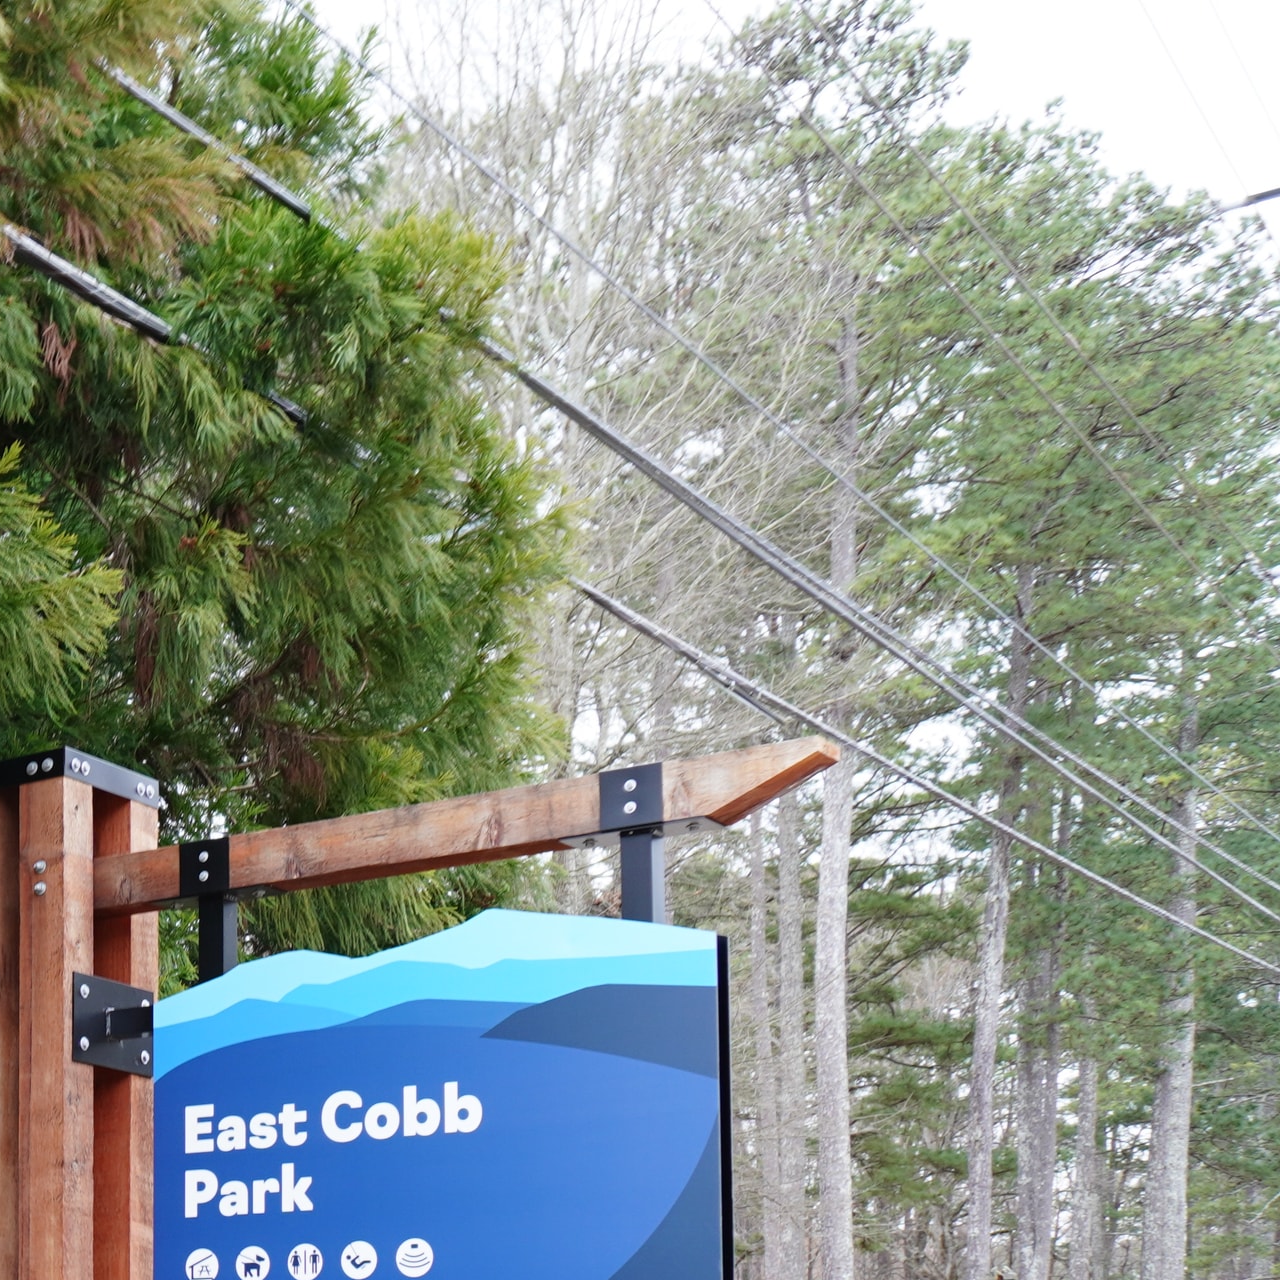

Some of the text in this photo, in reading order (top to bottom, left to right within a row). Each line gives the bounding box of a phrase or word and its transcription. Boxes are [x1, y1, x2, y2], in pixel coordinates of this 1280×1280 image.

[184, 1081, 483, 1154] East Cobb
[184, 1163, 314, 1219] Park
